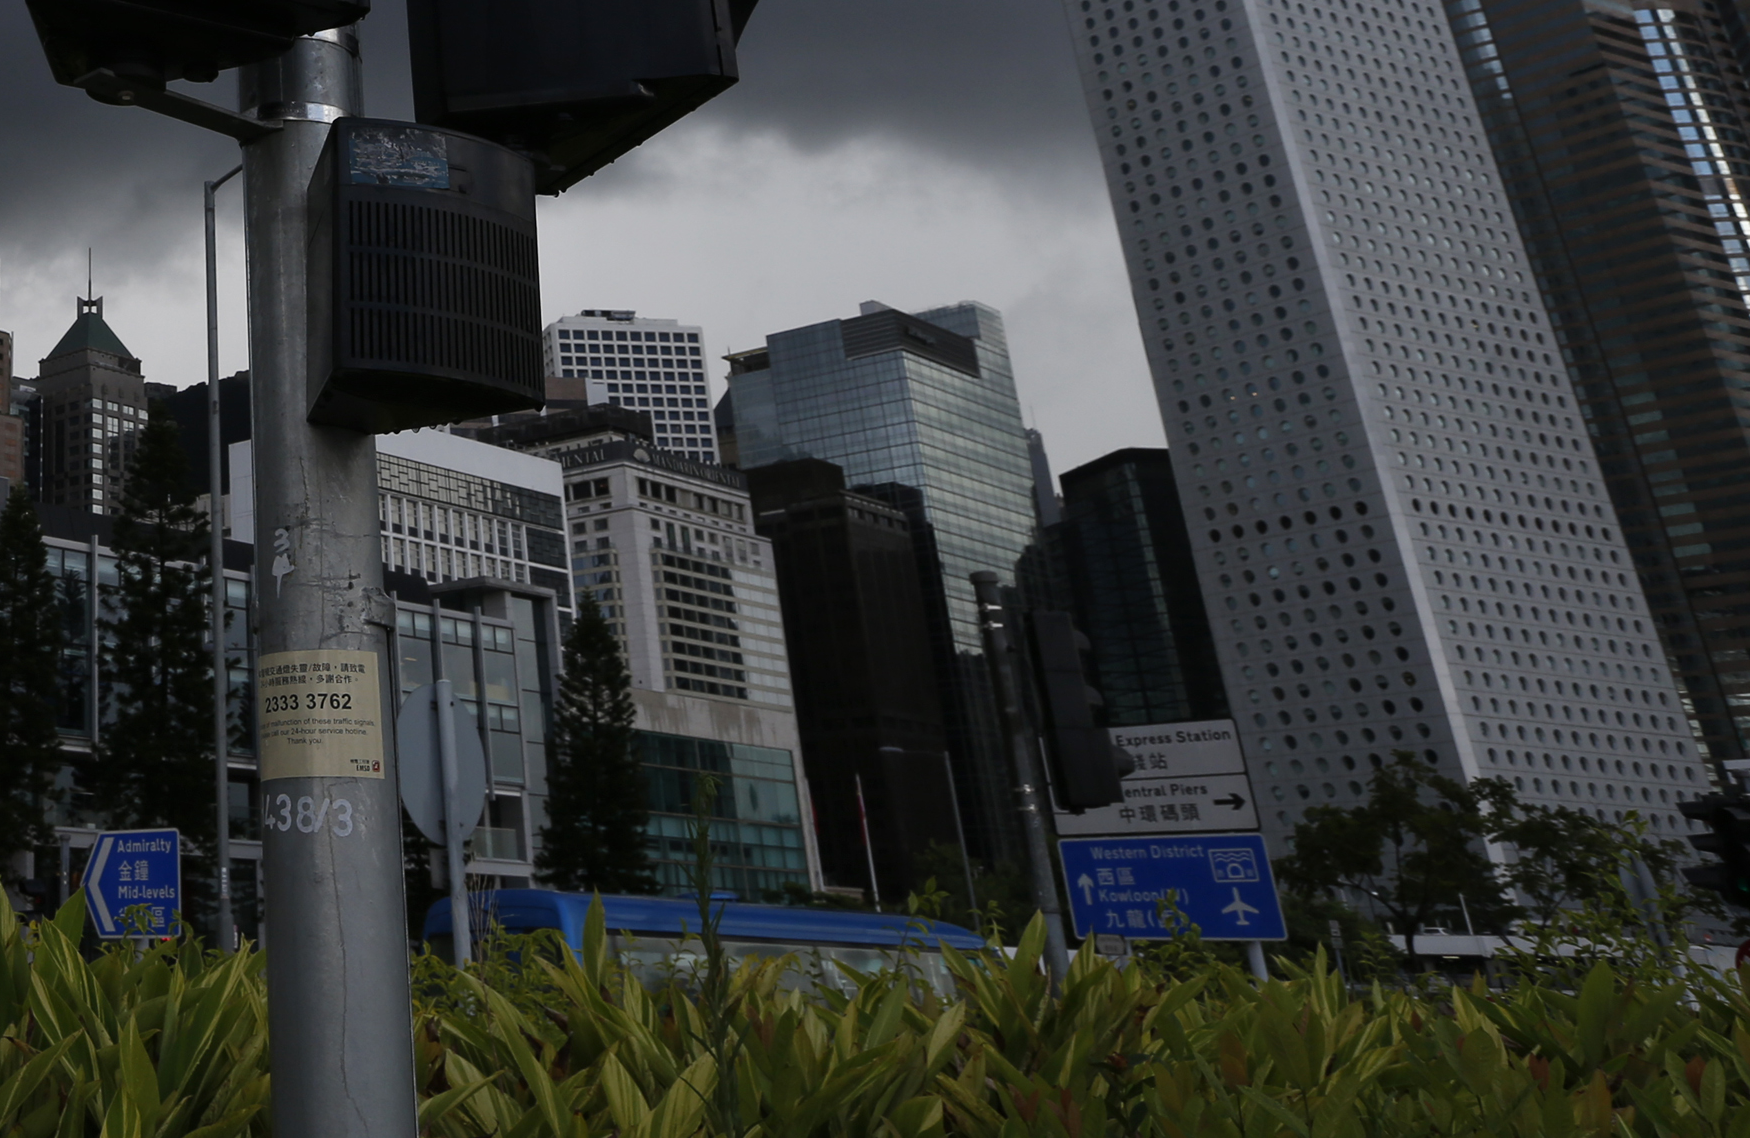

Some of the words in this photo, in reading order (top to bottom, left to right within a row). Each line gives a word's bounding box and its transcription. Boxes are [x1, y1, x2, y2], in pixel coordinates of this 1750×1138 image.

[265, 694, 299, 713] 2333
[306, 693, 352, 710] 3762
[291, 727, 316, 736] 24-hour
[1116, 733, 1172, 747] Express
[1176, 730, 1231, 744] Station
[1123, 785, 1167, 799] entral
[1170, 783, 1208, 797] Piers
[1119, 803, 1201, 824] 中環碼頭
[117, 838, 172, 854] Admiralty
[1090, 846, 1148, 860] Western
[1150, 844, 1205, 859] District
[118, 860, 149, 881] 金鐘
[1095, 866, 1136, 886] 西區
[118, 885, 176, 899] Mid-levels
